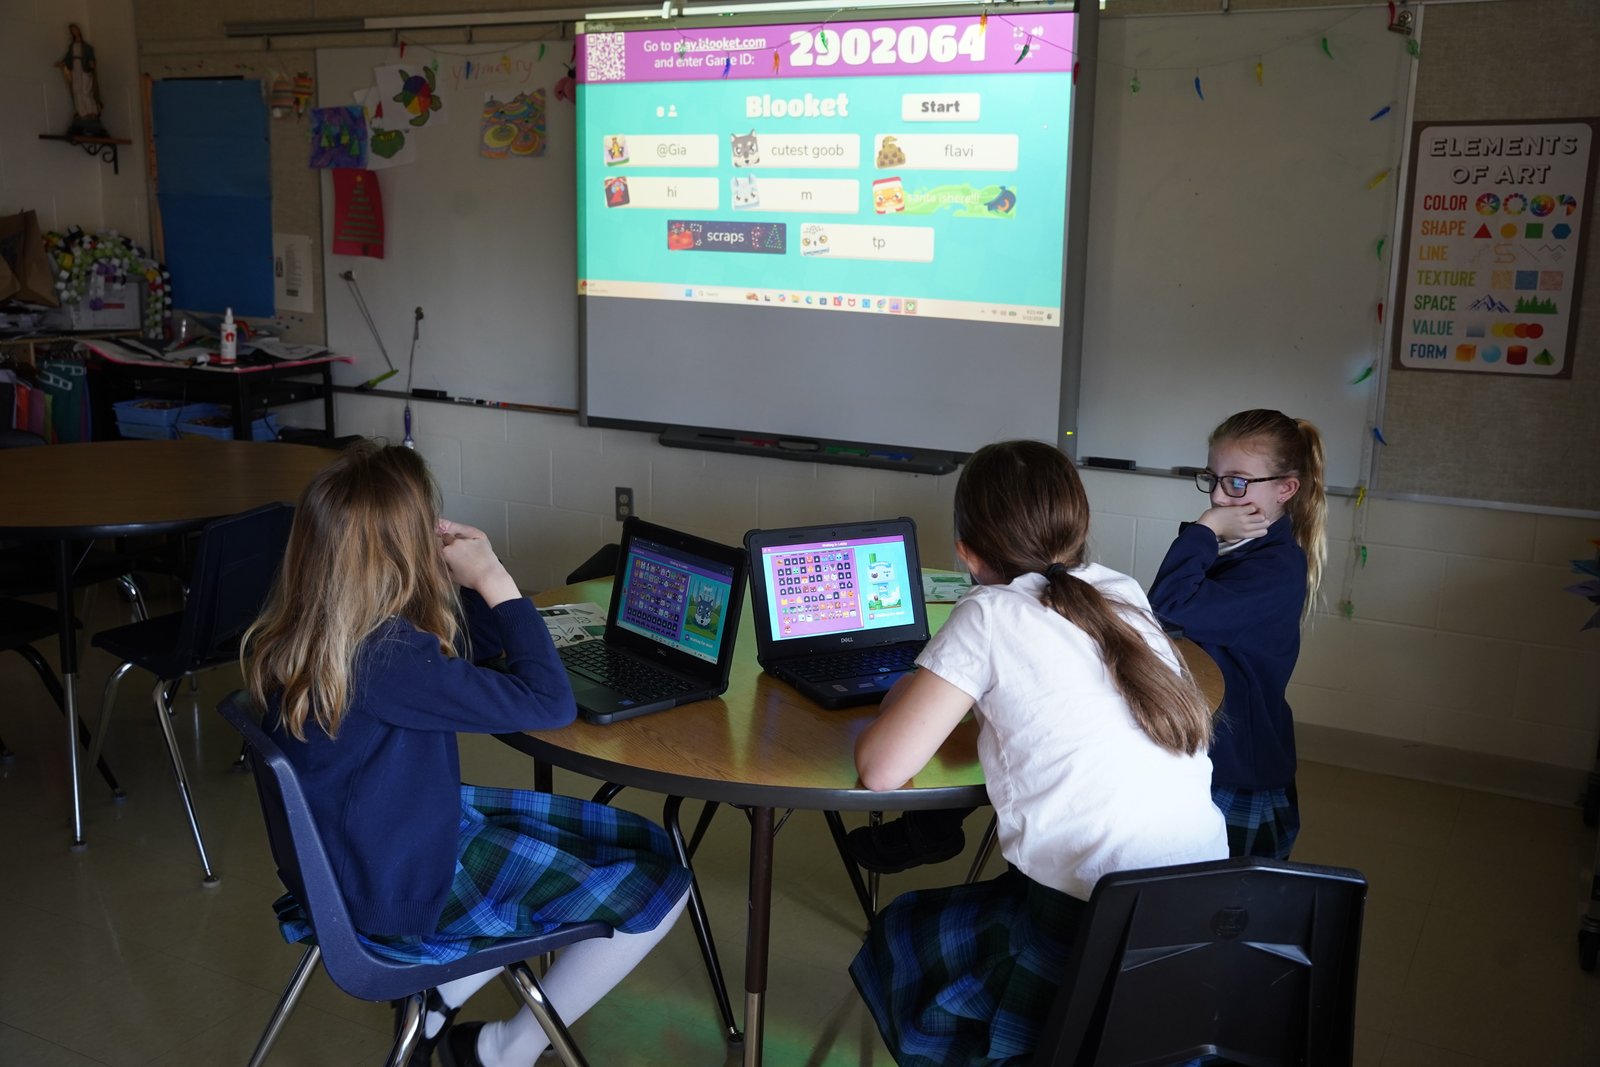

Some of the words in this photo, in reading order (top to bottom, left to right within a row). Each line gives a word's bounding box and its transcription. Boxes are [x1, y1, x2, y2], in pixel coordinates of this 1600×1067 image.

[643, 40, 658, 52] Go
[660, 41, 671, 51] to
[673, 36, 767, 53] play.blooket.com
[789, 24, 987, 67] 2902064
[654, 57, 674, 68] and
[676, 55, 703, 67] enter
[739, 53, 755, 65] ID:
[745, 92, 849, 118] Blooket
[920, 101, 961, 113] Start
[656, 143, 687, 158] @Gia
[771, 144, 809, 157] cutest
[812, 142, 844, 159] goob
[944, 144, 975, 157] flavi
[1430, 136, 1578, 157] ELEMENTS
[1452, 165, 1489, 185] OF
[1495, 164, 1551, 185] ART
[667, 186, 677, 198] hi
[801, 190, 813, 200] m
[1424, 194, 1468, 211] COLOR
[1421, 220, 1466, 236] SHAPE
[707, 230, 745, 244] scraps
[872, 236, 886, 250] tp
[1419, 245, 1448, 261] LINE
[1417, 270, 1477, 287] TEXTURE
[1414, 294, 1456, 311] SPACE
[1413, 319, 1454, 336] VALUE
[1410, 343, 1447, 359] FORM
[840, 636, 854, 644] DELL
